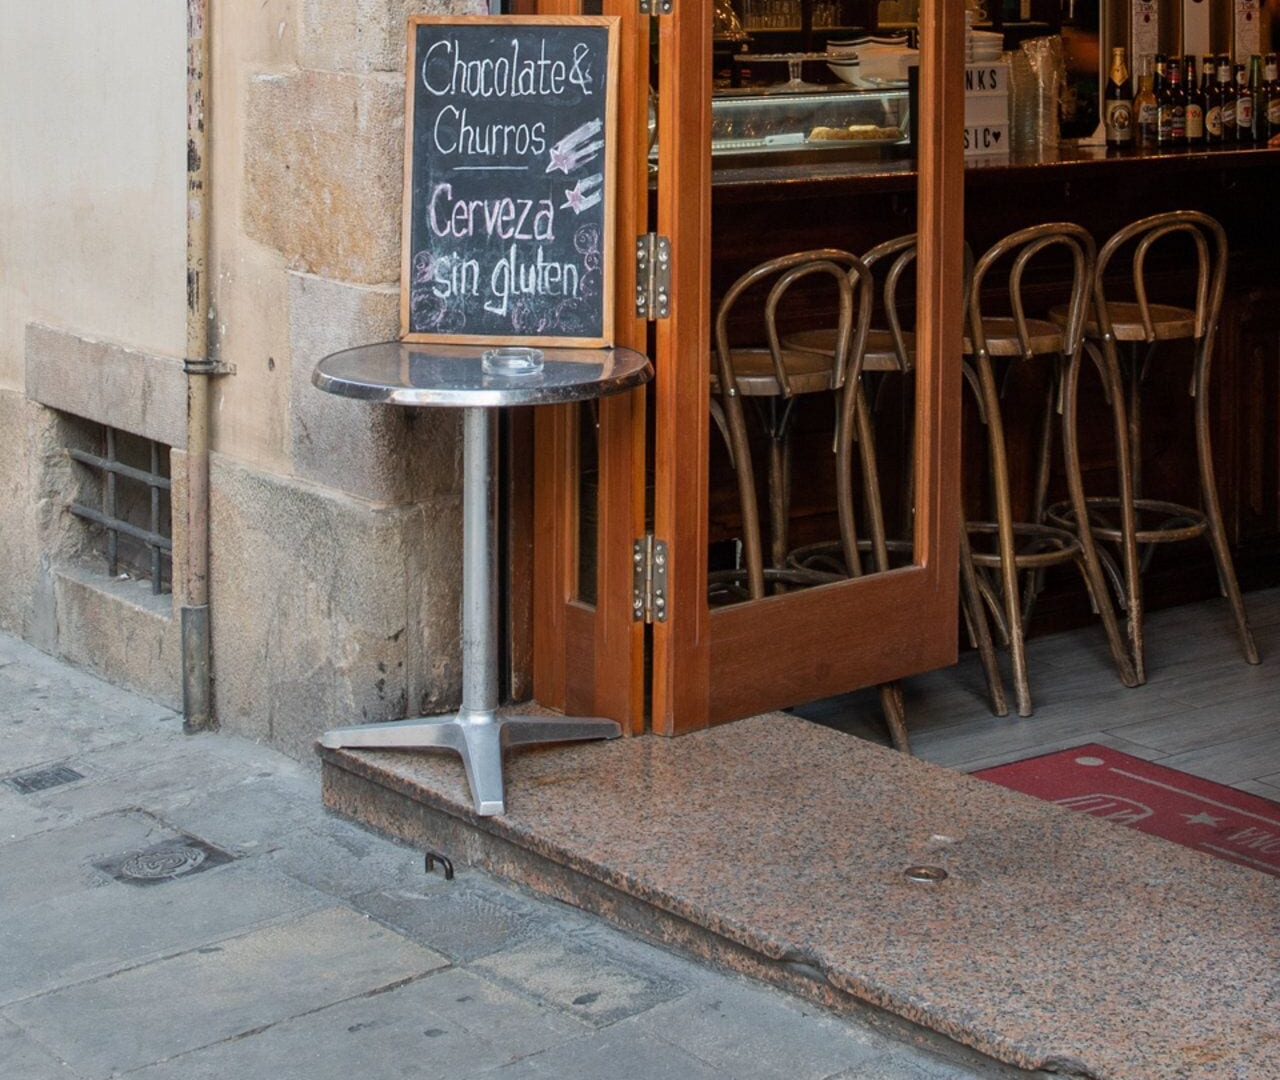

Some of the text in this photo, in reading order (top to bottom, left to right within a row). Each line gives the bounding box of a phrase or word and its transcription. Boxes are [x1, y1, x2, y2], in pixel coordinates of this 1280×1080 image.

[433, 104, 546, 156] Churros
[430, 182, 555, 241] Cerveza
[432, 244, 579, 316] sin gluten
